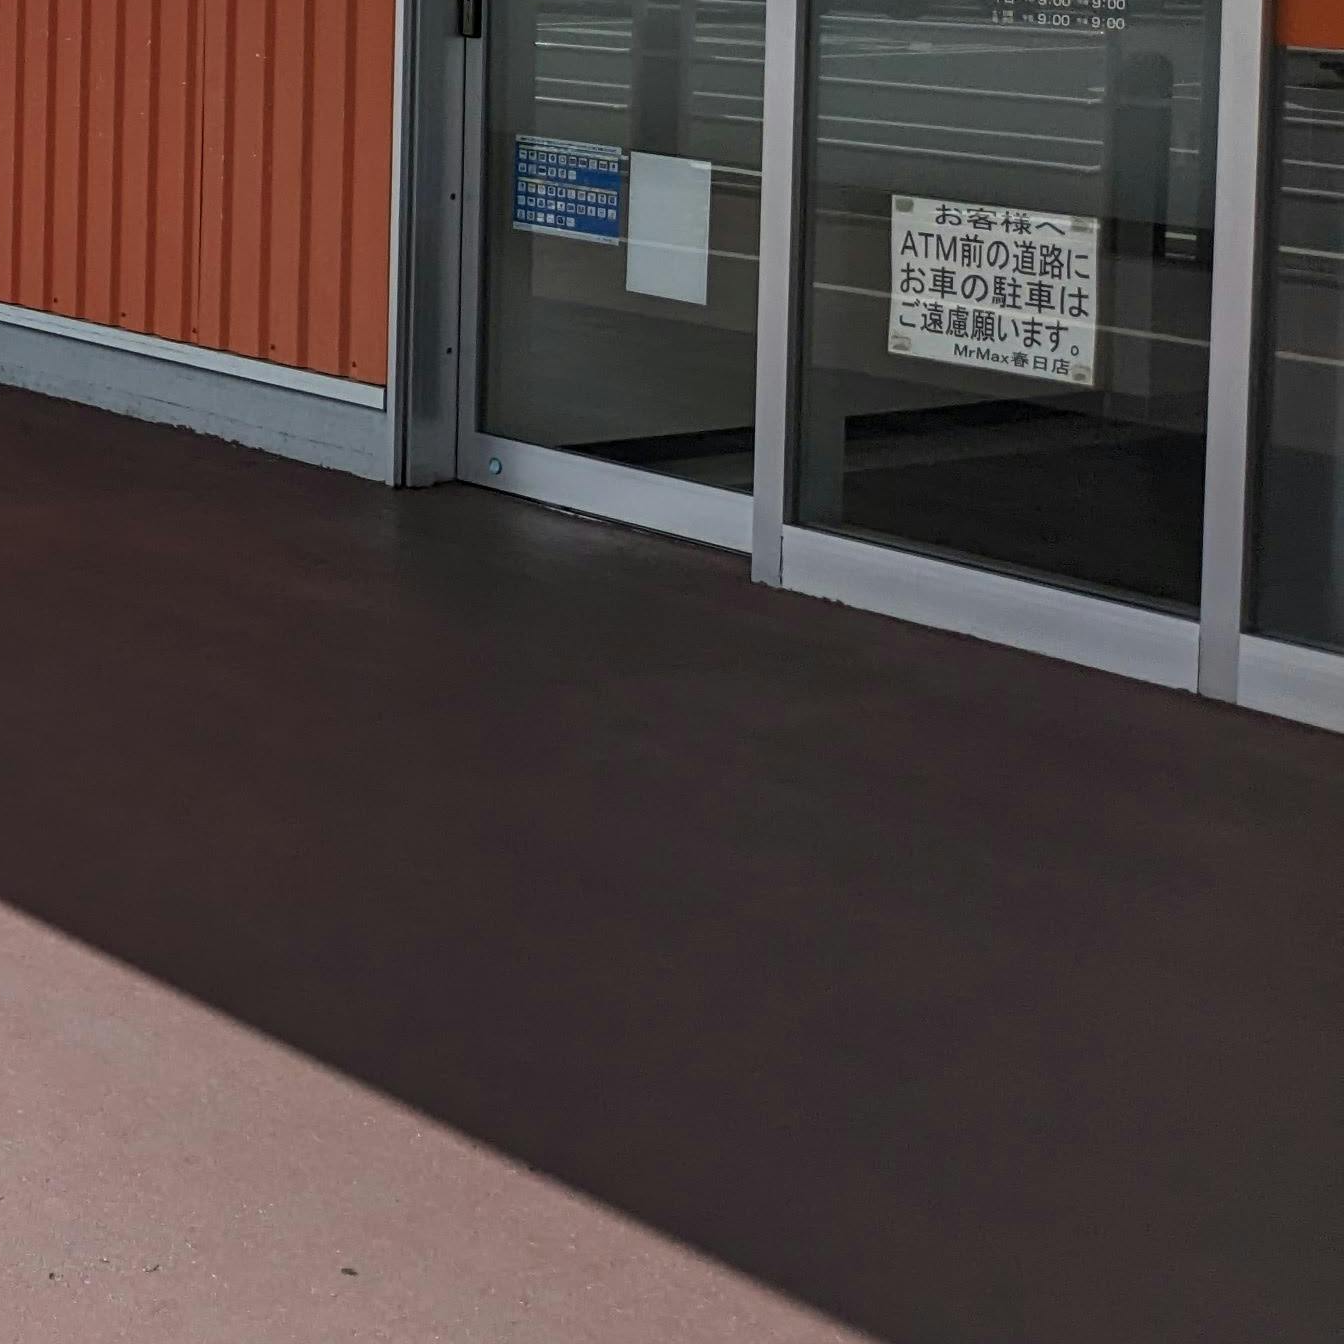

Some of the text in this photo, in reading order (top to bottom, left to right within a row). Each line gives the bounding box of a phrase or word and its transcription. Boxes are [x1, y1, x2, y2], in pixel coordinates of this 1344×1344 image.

[1037, 13, 1070, 27] 9:00
[1091, 16, 1125, 30] 9:00
[935, 204, 1066, 236] お客様へ
[900, 230, 1090, 280] ATM前の道路に
[900, 262, 1090, 318] お車の駐車は
[899, 297, 1080, 357] ご遠慮願います。
[953, 343, 1072, 376] MrMax春日店
